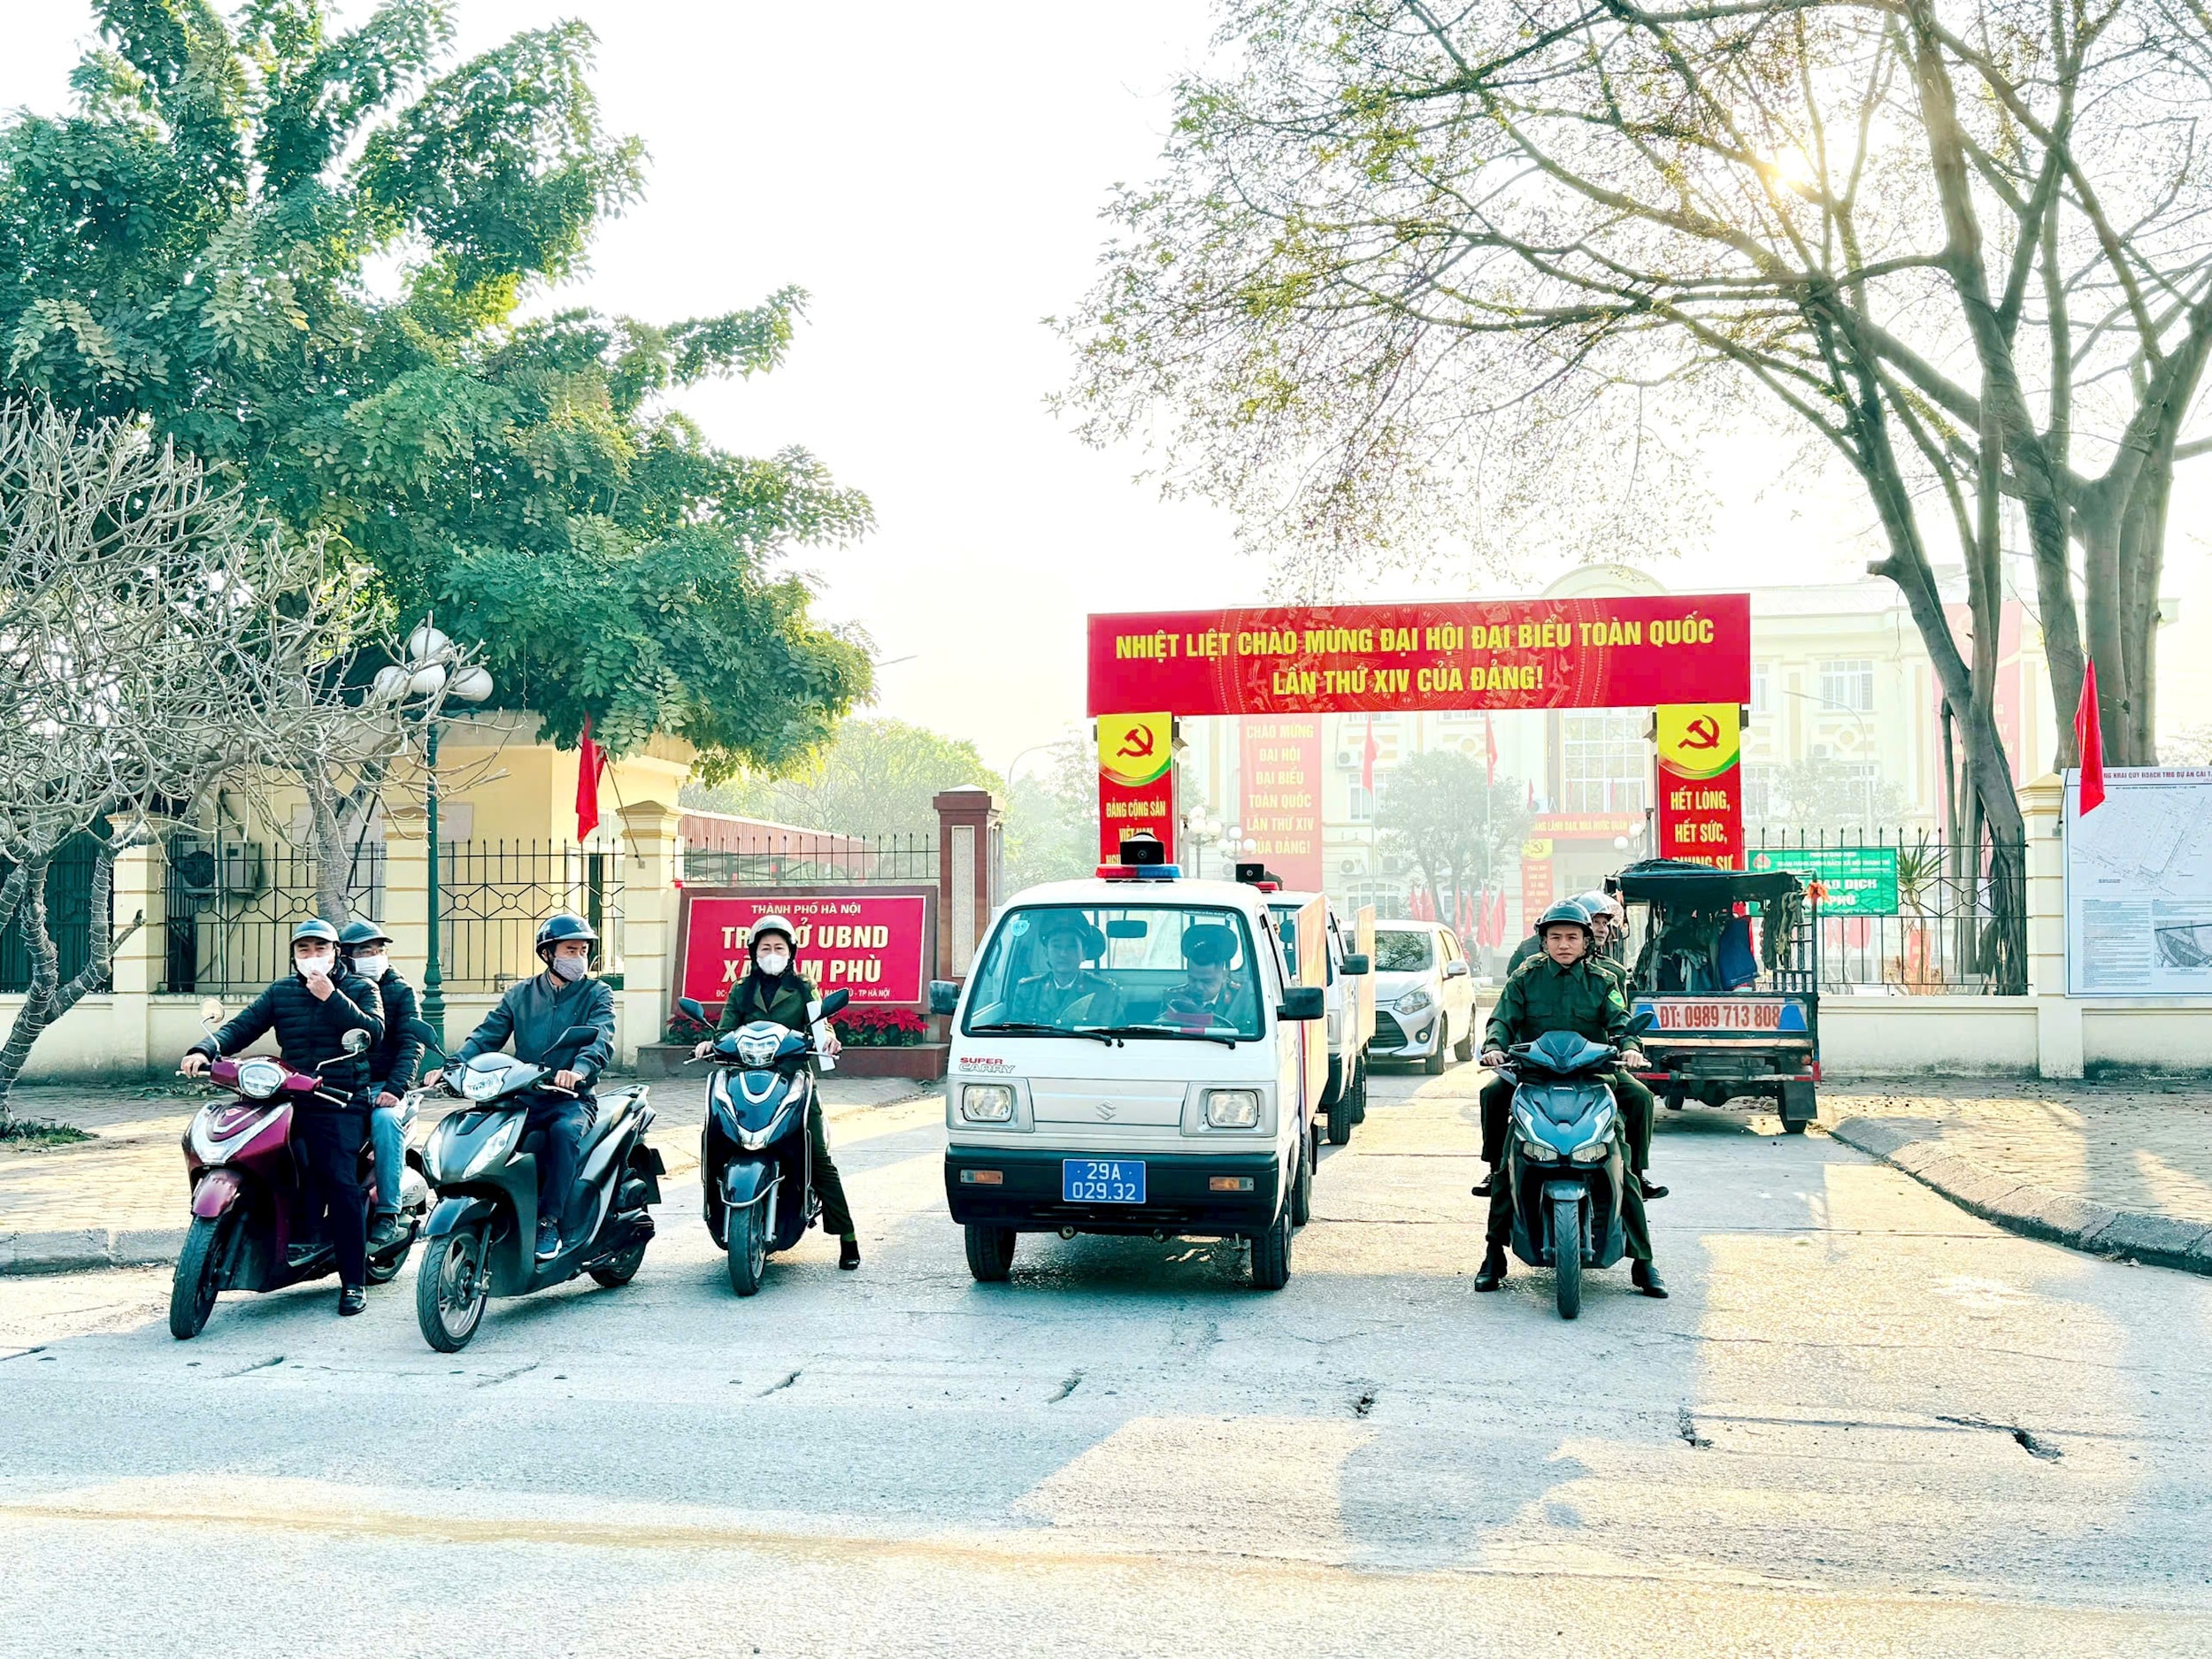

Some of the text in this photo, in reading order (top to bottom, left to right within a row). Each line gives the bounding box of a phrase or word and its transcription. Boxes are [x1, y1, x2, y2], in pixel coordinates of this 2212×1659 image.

[1116, 611, 1715, 663] NHIỆT LIỆT CHÀO MỪNG ĐẠI HỘI ĐẠI BIỂU TOÀN QUỐC
[1272, 658, 1543, 695] LẦN THỨ XIV CỦA ĐẢNG!
[1281, 745, 1302, 764] HỘI
[1278, 765, 1304, 786] BIỂU
[1106, 795, 1166, 820] ĐẢNG CỘNG SẢN
[1248, 788, 1311, 810] TOÀN QUỐC
[1671, 786, 1730, 811] HẾT LÒNG,
[1295, 817, 1314, 832] XIV
[1674, 818, 1728, 844] HẾT SỨC,
[751, 902, 861, 917] THÀNH PHỐ HÀ NỘI
[721, 917, 889, 949] TR Ở UBND
[830, 954, 882, 983] PHÙ
[867, 987, 878, 997] HÀ
[1660, 1005, 1780, 1028] ĐT: 0989 713 808
[958, 1063, 1017, 1073] CARRY
[1087, 1162, 1122, 1181] 29A
[1072, 1181, 1136, 1201] 029.32
